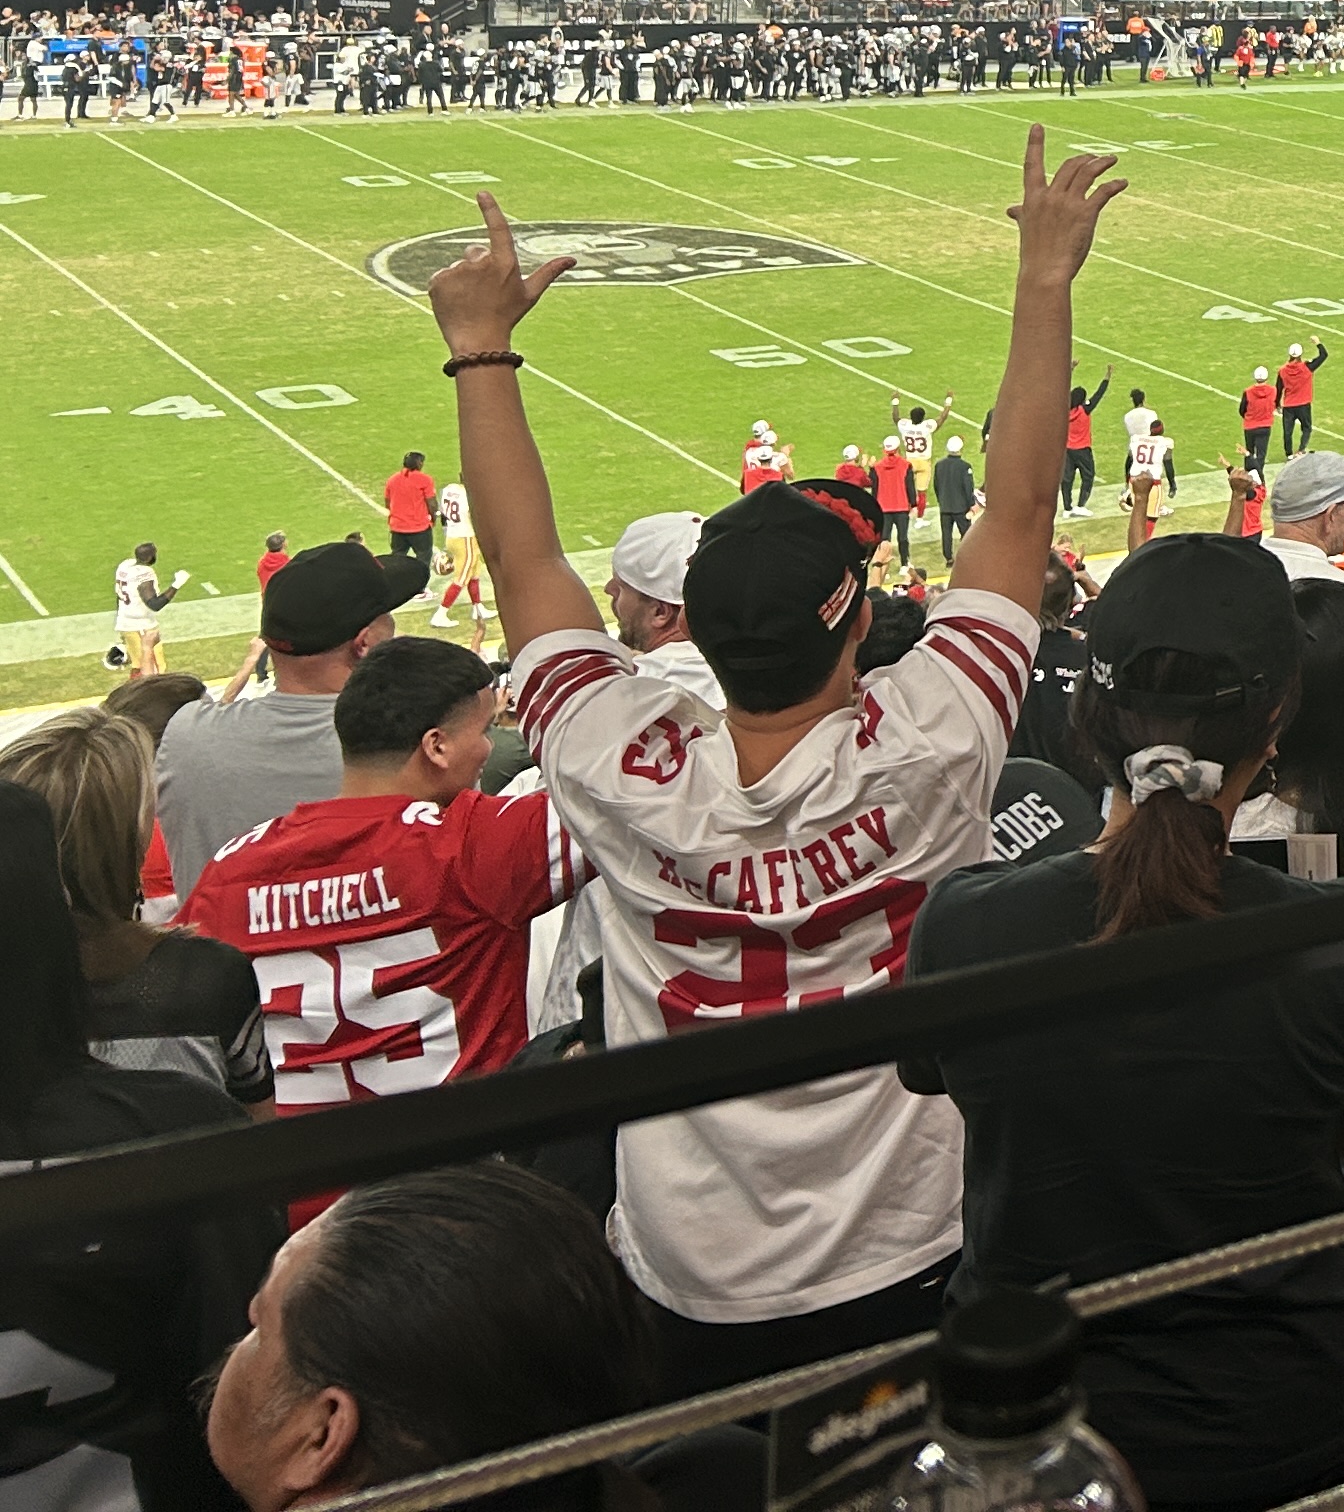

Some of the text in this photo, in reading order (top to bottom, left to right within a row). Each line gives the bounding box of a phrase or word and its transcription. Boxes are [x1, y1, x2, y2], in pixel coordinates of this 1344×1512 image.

[709, 336, 913, 367] 50
[129, 383, 359, 420] 40
[904, 435, 928, 453] 83
[1135, 444, 1156, 466] 61
[247, 866, 401, 935] MITCHELL
[252, 928, 461, 1106] 25
